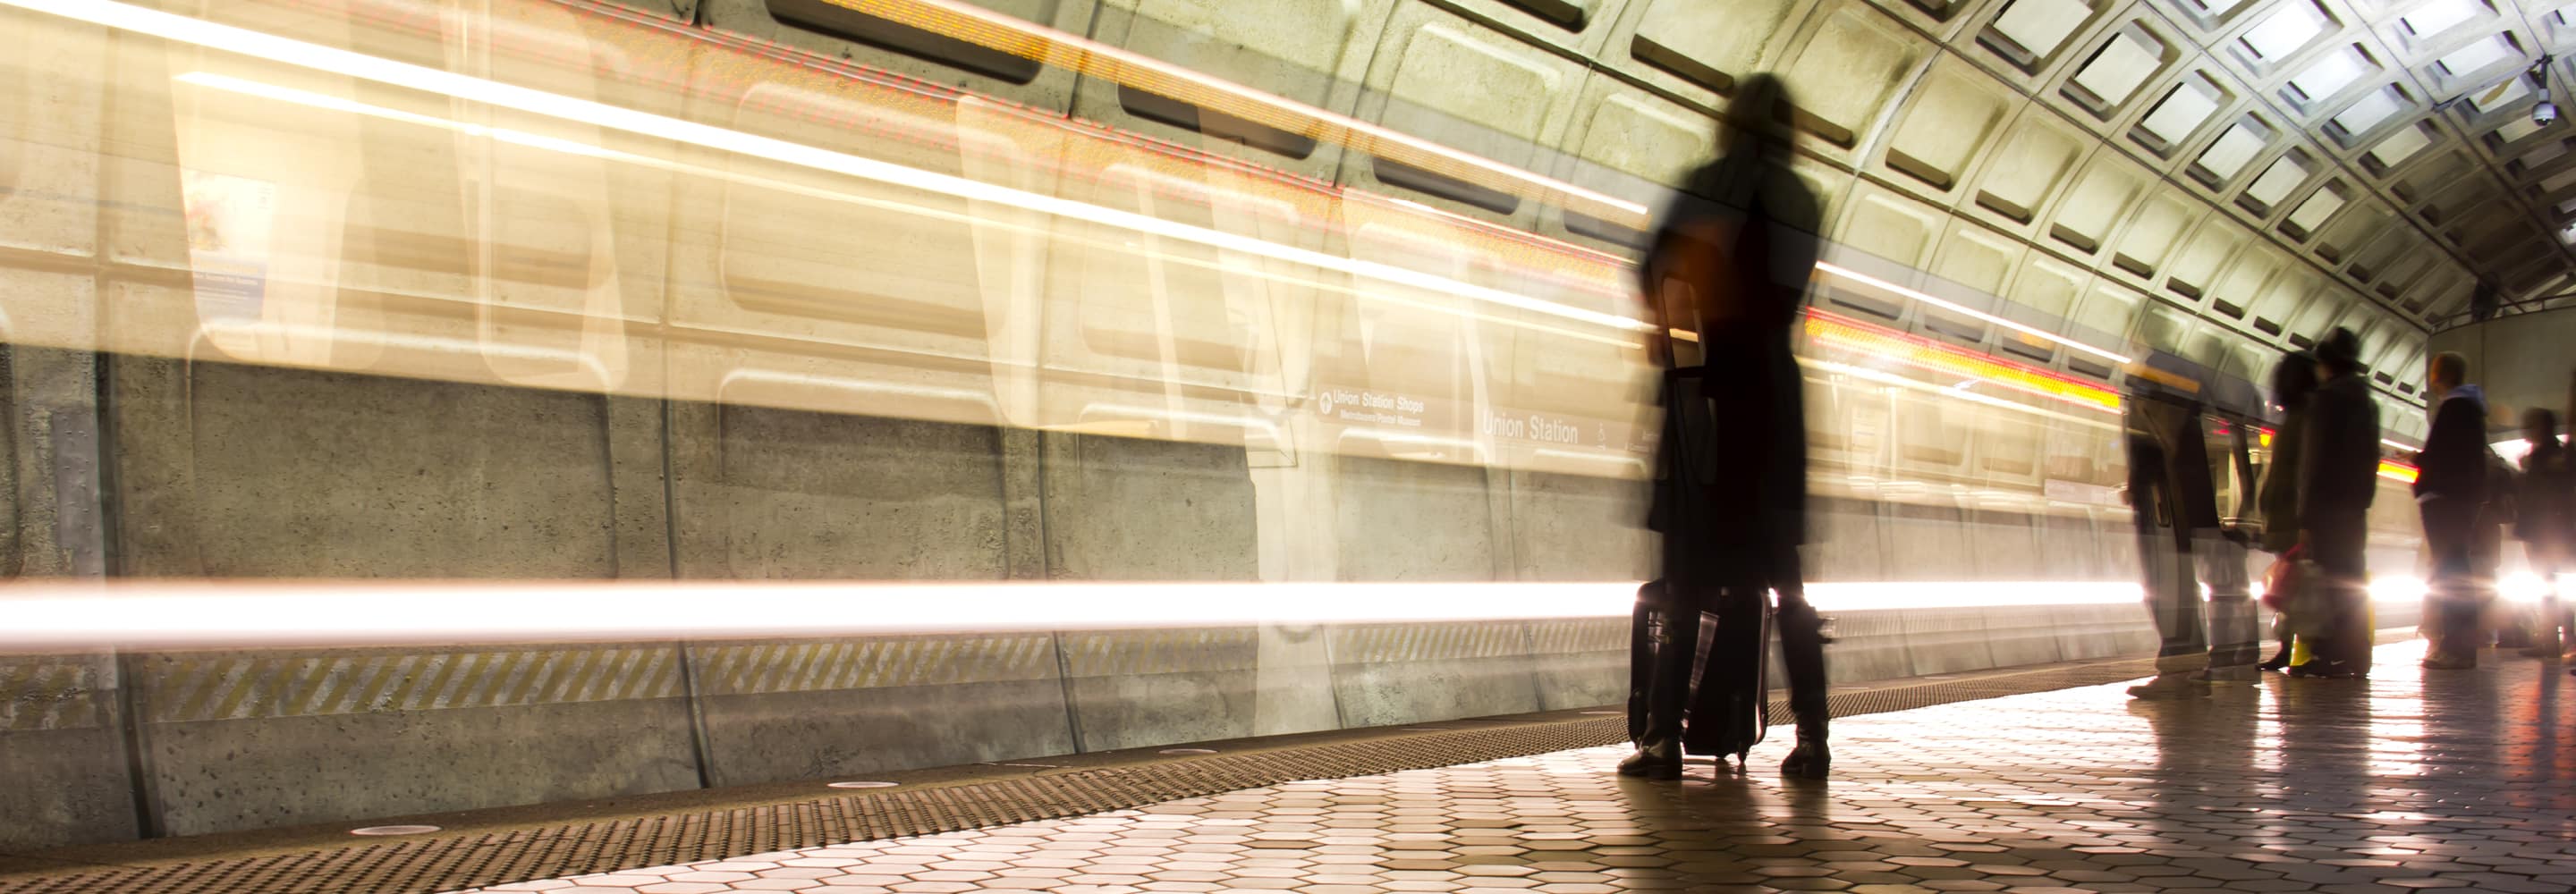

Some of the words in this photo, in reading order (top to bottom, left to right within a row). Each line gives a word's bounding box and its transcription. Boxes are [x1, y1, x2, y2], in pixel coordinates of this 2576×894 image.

[1334, 390, 1360, 405] Union
[1361, 392, 1394, 409] Station
[1397, 396, 1424, 414] Shops
[1483, 408, 1523, 437] Union
[1530, 415, 1578, 444] Station
